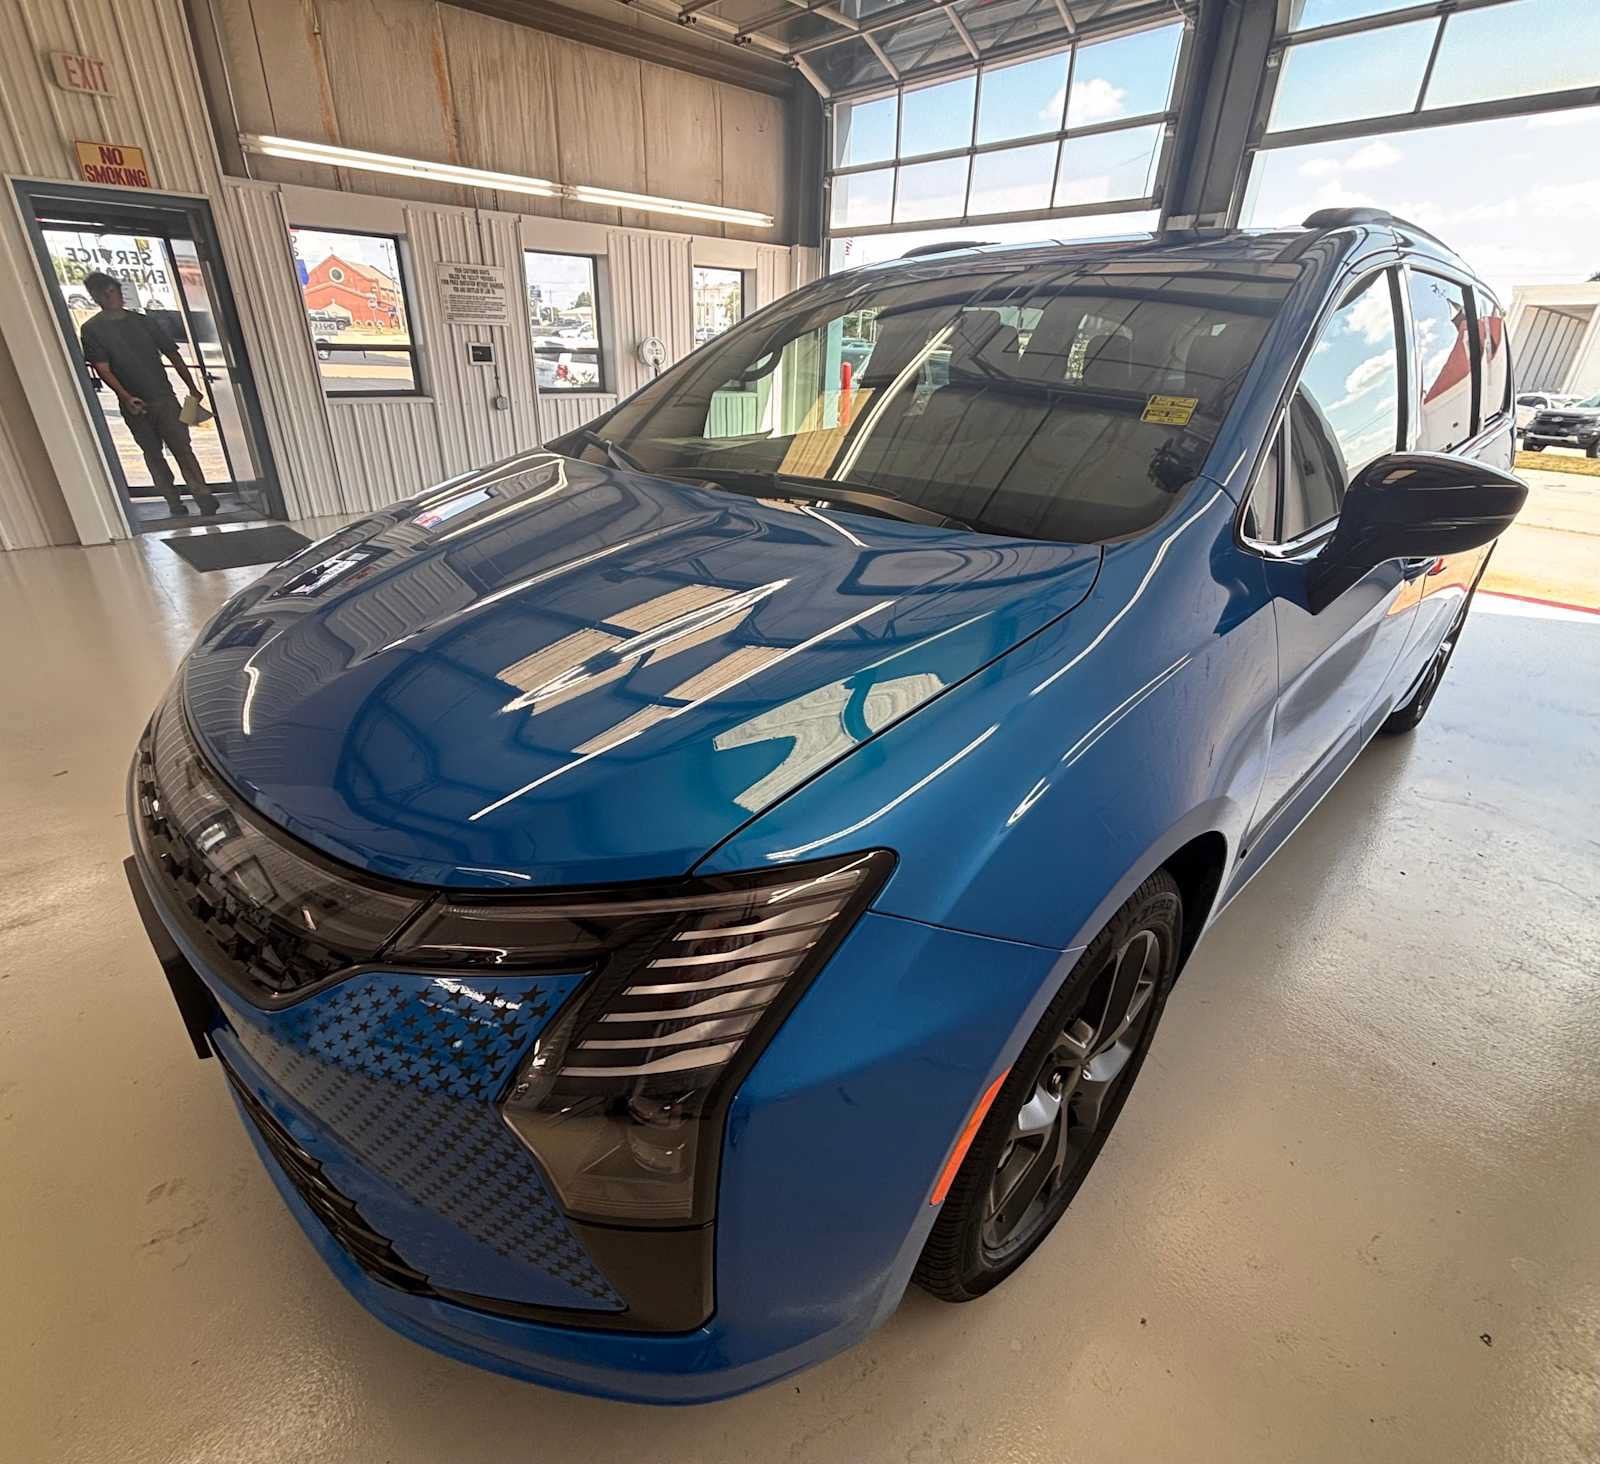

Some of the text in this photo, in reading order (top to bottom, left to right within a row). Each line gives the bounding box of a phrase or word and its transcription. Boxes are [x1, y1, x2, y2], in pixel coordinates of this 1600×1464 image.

[62, 55, 108, 92] EXIT
[98, 146, 124, 166] NO
[84, 164, 148, 188] SMOKING
